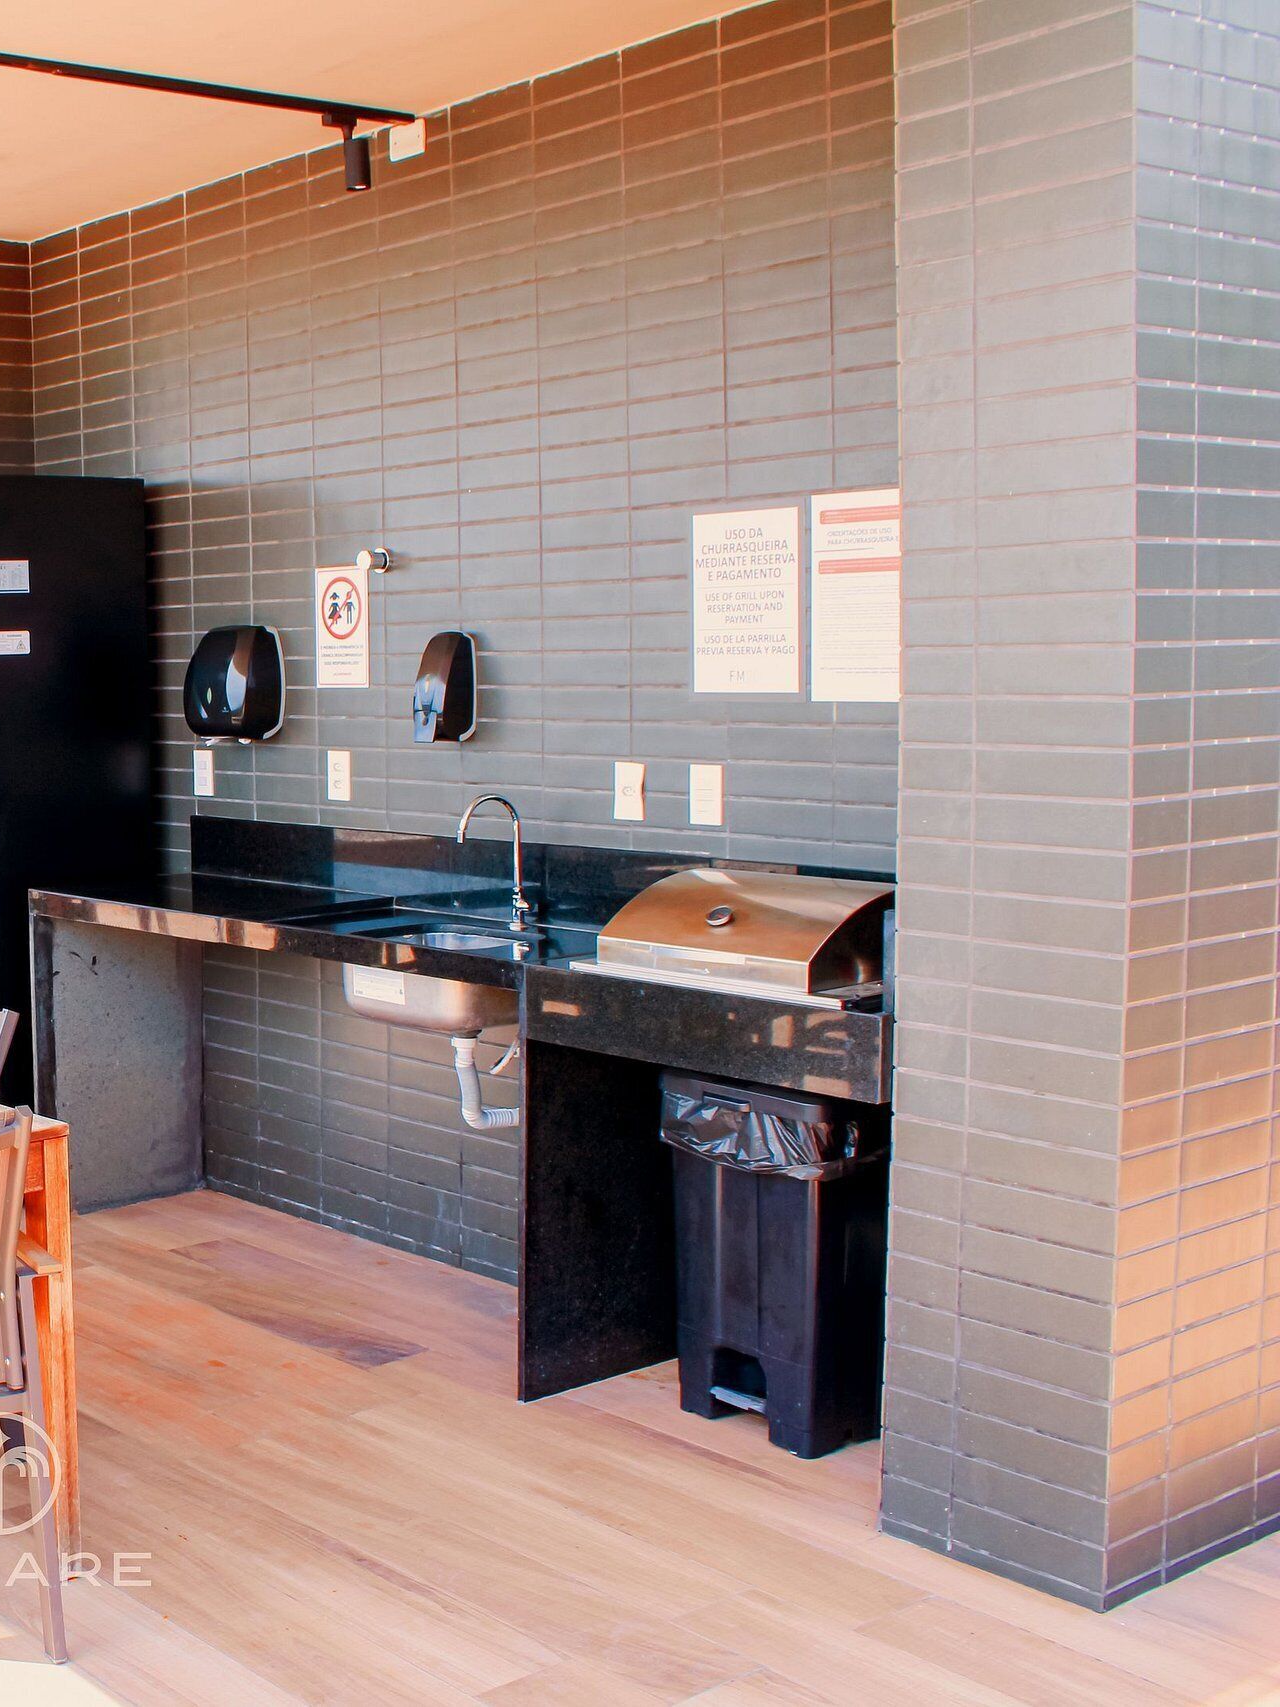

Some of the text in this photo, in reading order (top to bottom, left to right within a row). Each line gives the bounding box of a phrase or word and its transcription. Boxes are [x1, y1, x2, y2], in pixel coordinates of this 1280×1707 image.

[724, 528, 763, 540] USO DA
[701, 540, 788, 555] CHURRASQUEIRA
[696, 553, 796, 568] MEDIANTE RESERVA
[708, 568, 781, 581] E PAGAMENTO
[705, 590, 785, 602] USE OF GRILL UPON
[707, 602, 783, 613] RESERVATION AND
[725, 614, 764, 623] PAYMENT
[704, 634, 786, 644] USO DE LA PARRILLA
[697, 645, 796, 656] PREVIA RESERVA Y PAGO
